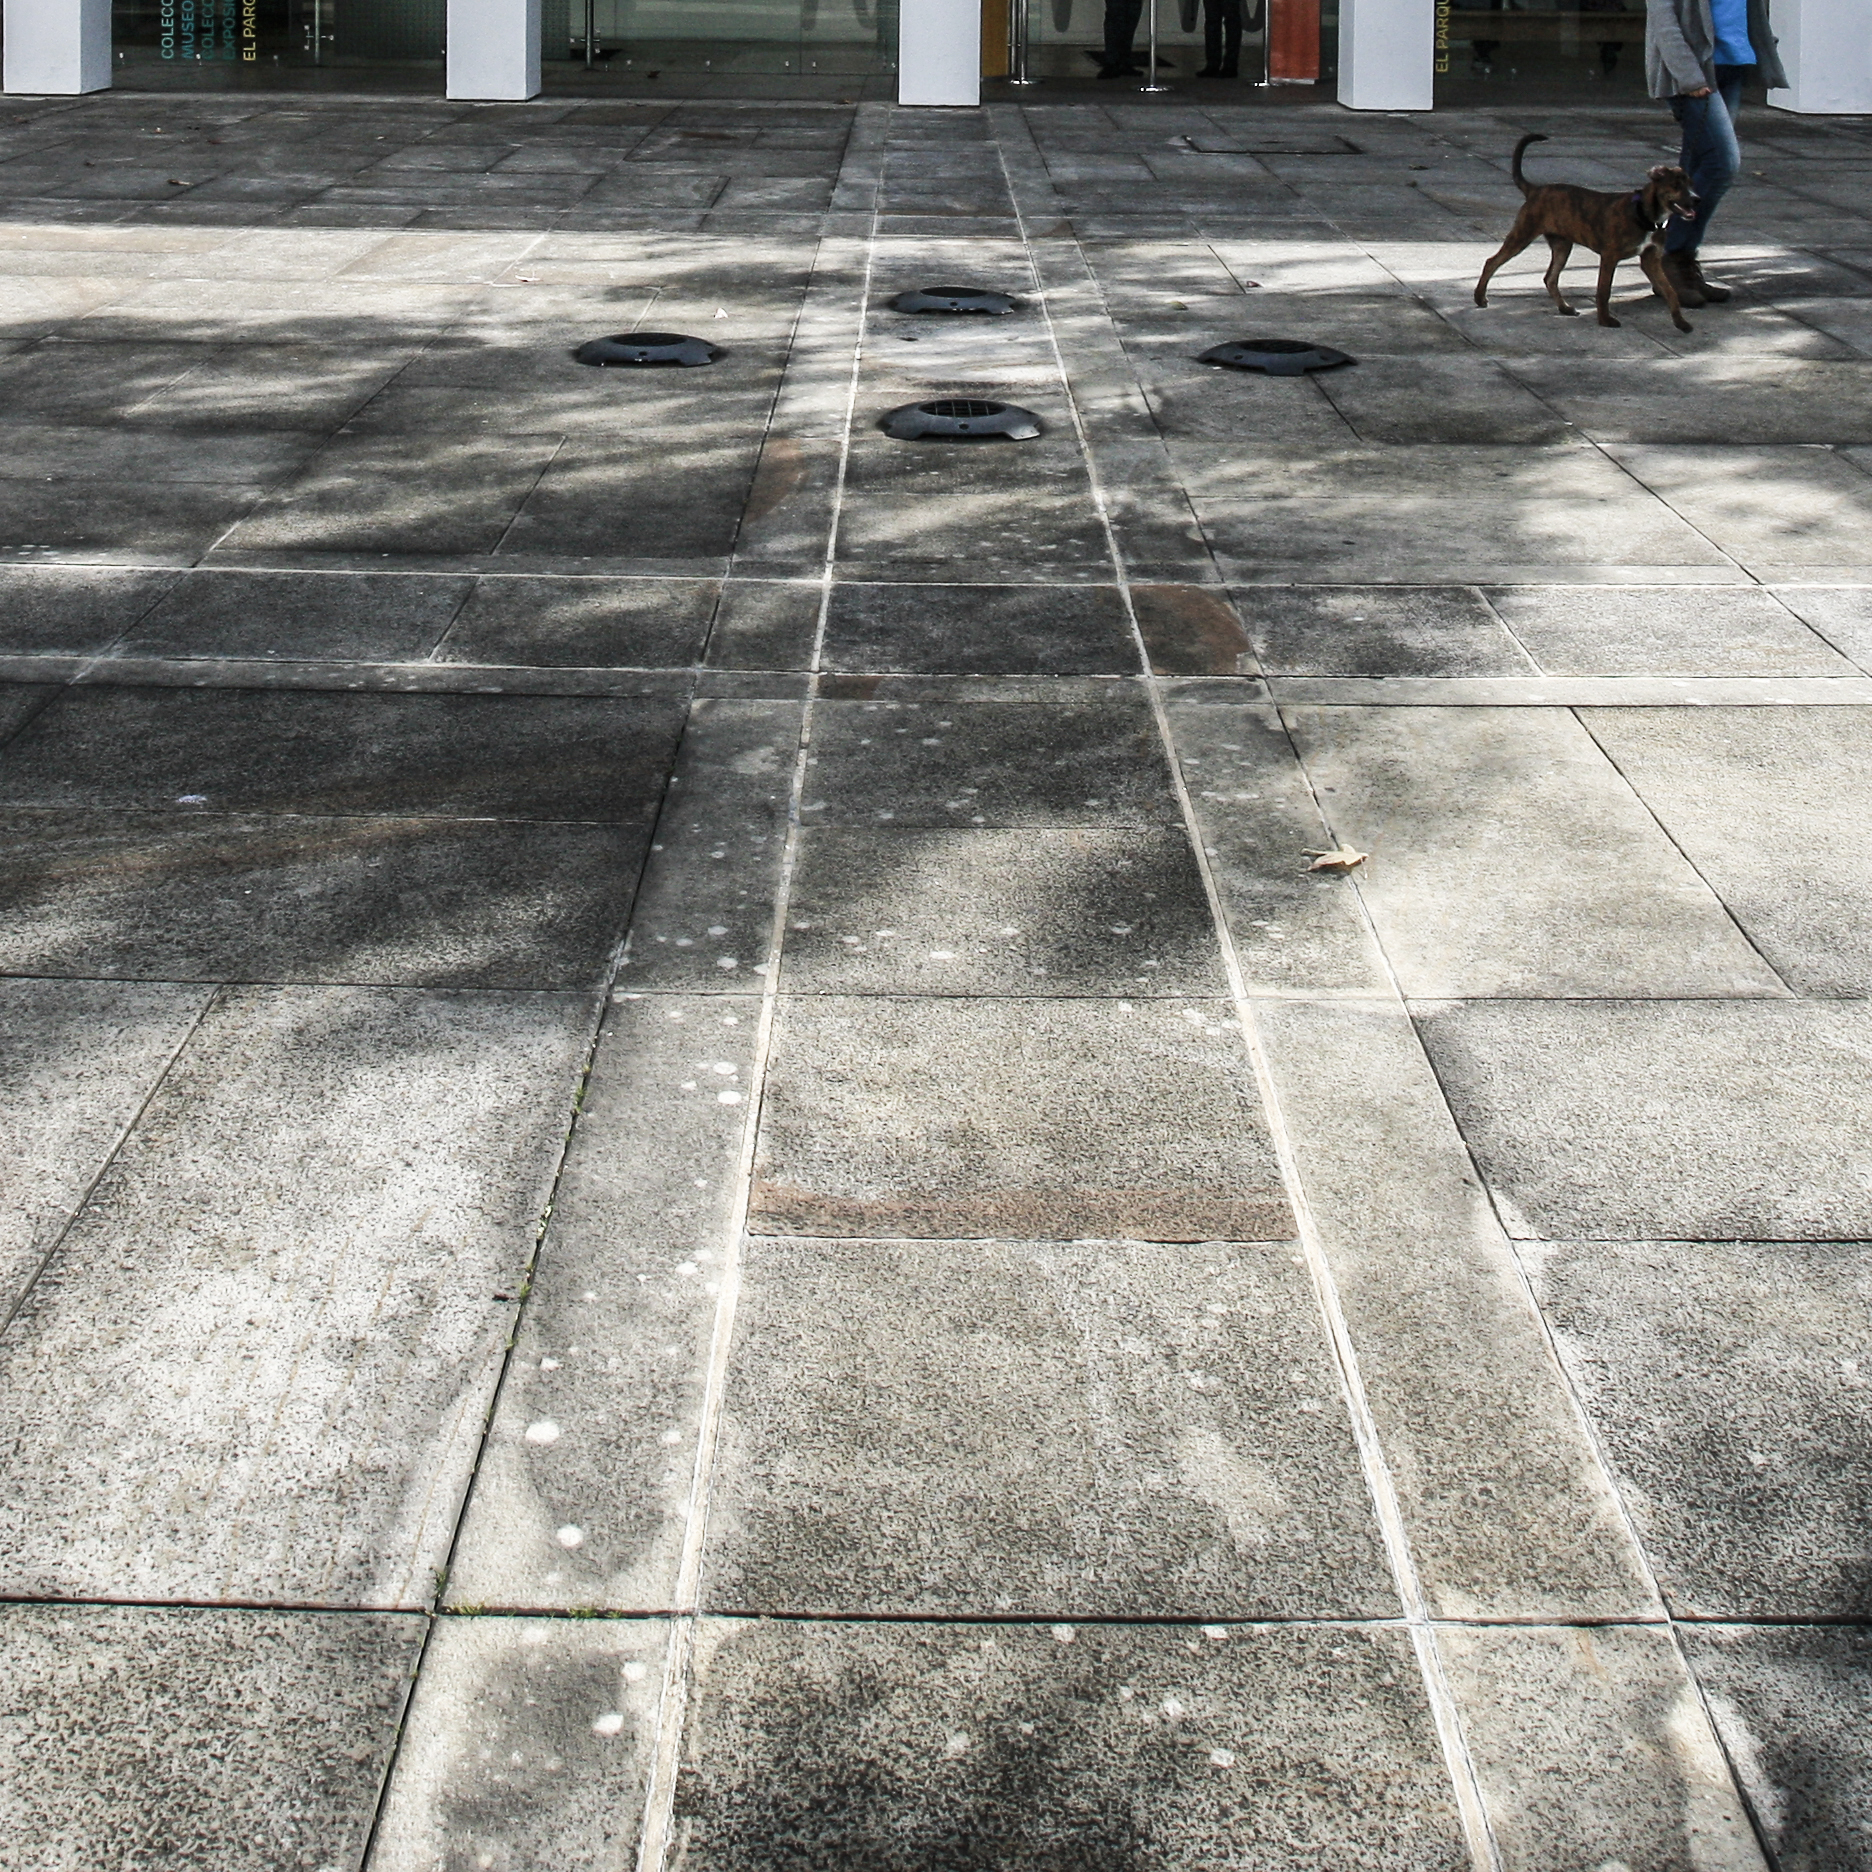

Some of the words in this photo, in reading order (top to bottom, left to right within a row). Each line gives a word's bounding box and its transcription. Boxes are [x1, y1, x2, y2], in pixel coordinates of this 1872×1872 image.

[181, 0, 195, 60] MUSEO
[243, 42, 257, 61] EL
[1436, 52, 1449, 73] EL
